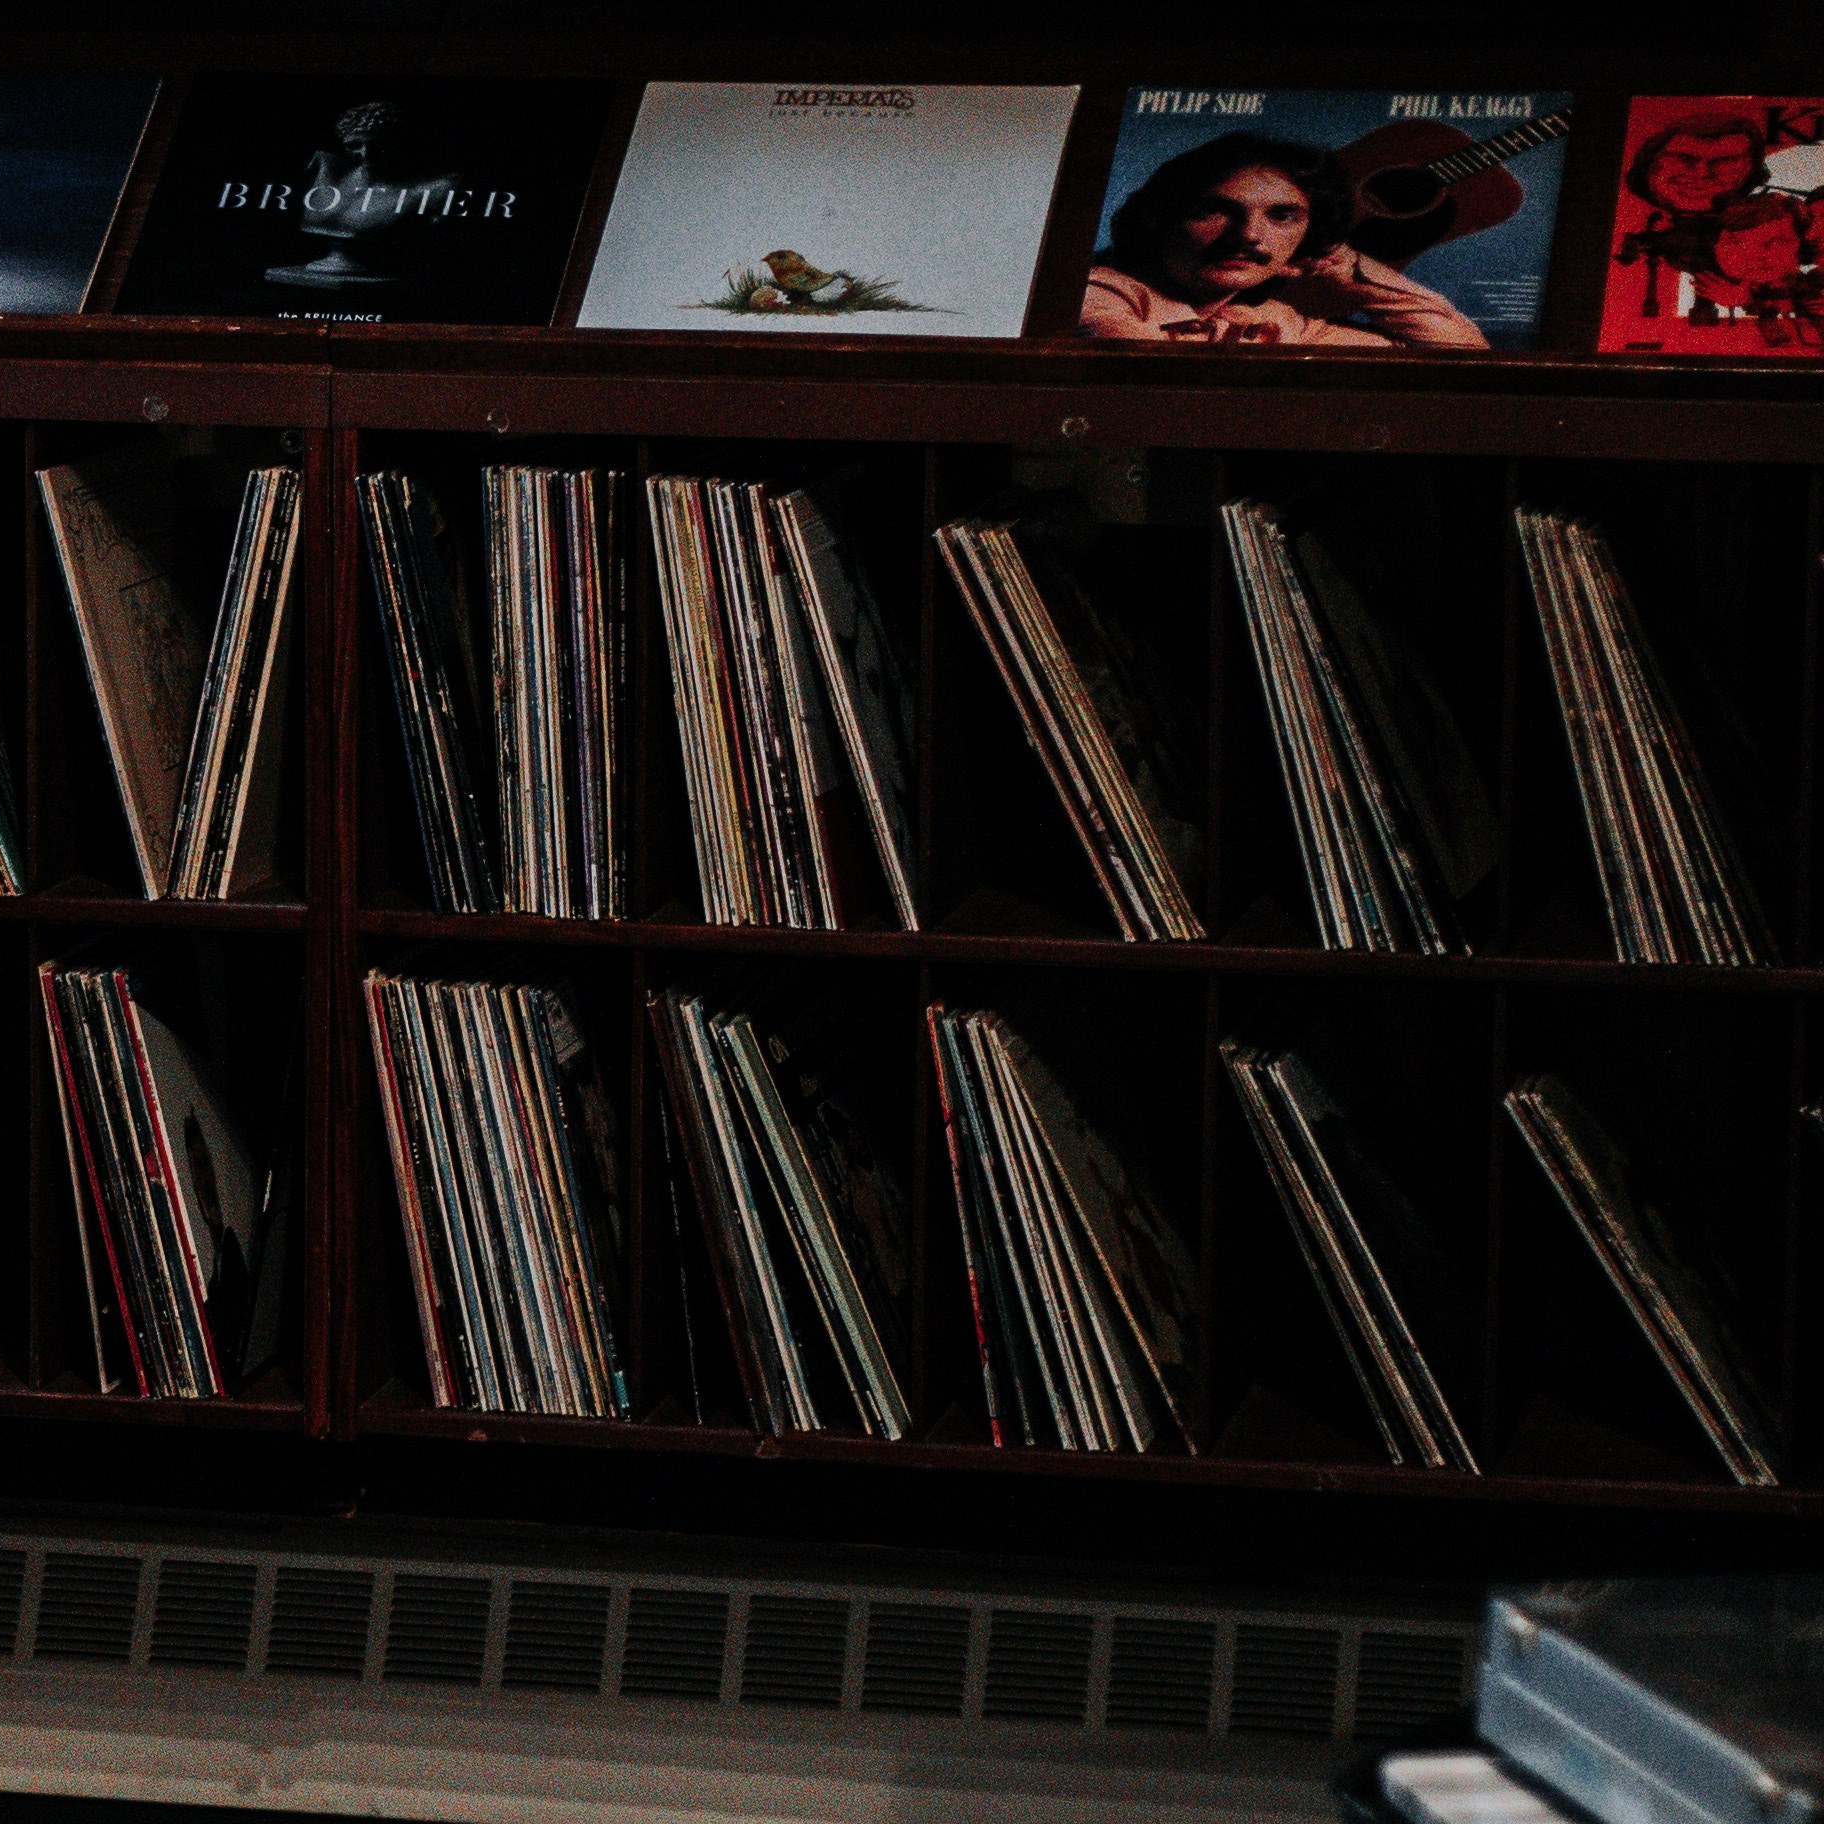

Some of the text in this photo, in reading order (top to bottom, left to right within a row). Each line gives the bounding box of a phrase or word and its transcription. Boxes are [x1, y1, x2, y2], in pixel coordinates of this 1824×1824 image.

[774, 89, 916, 110] IMPERIALS
[1213, 91, 1267, 115] SIDE
[1388, 93, 1535, 118] PHIL KEAGGY
[217, 182, 517, 218] BROTHER
